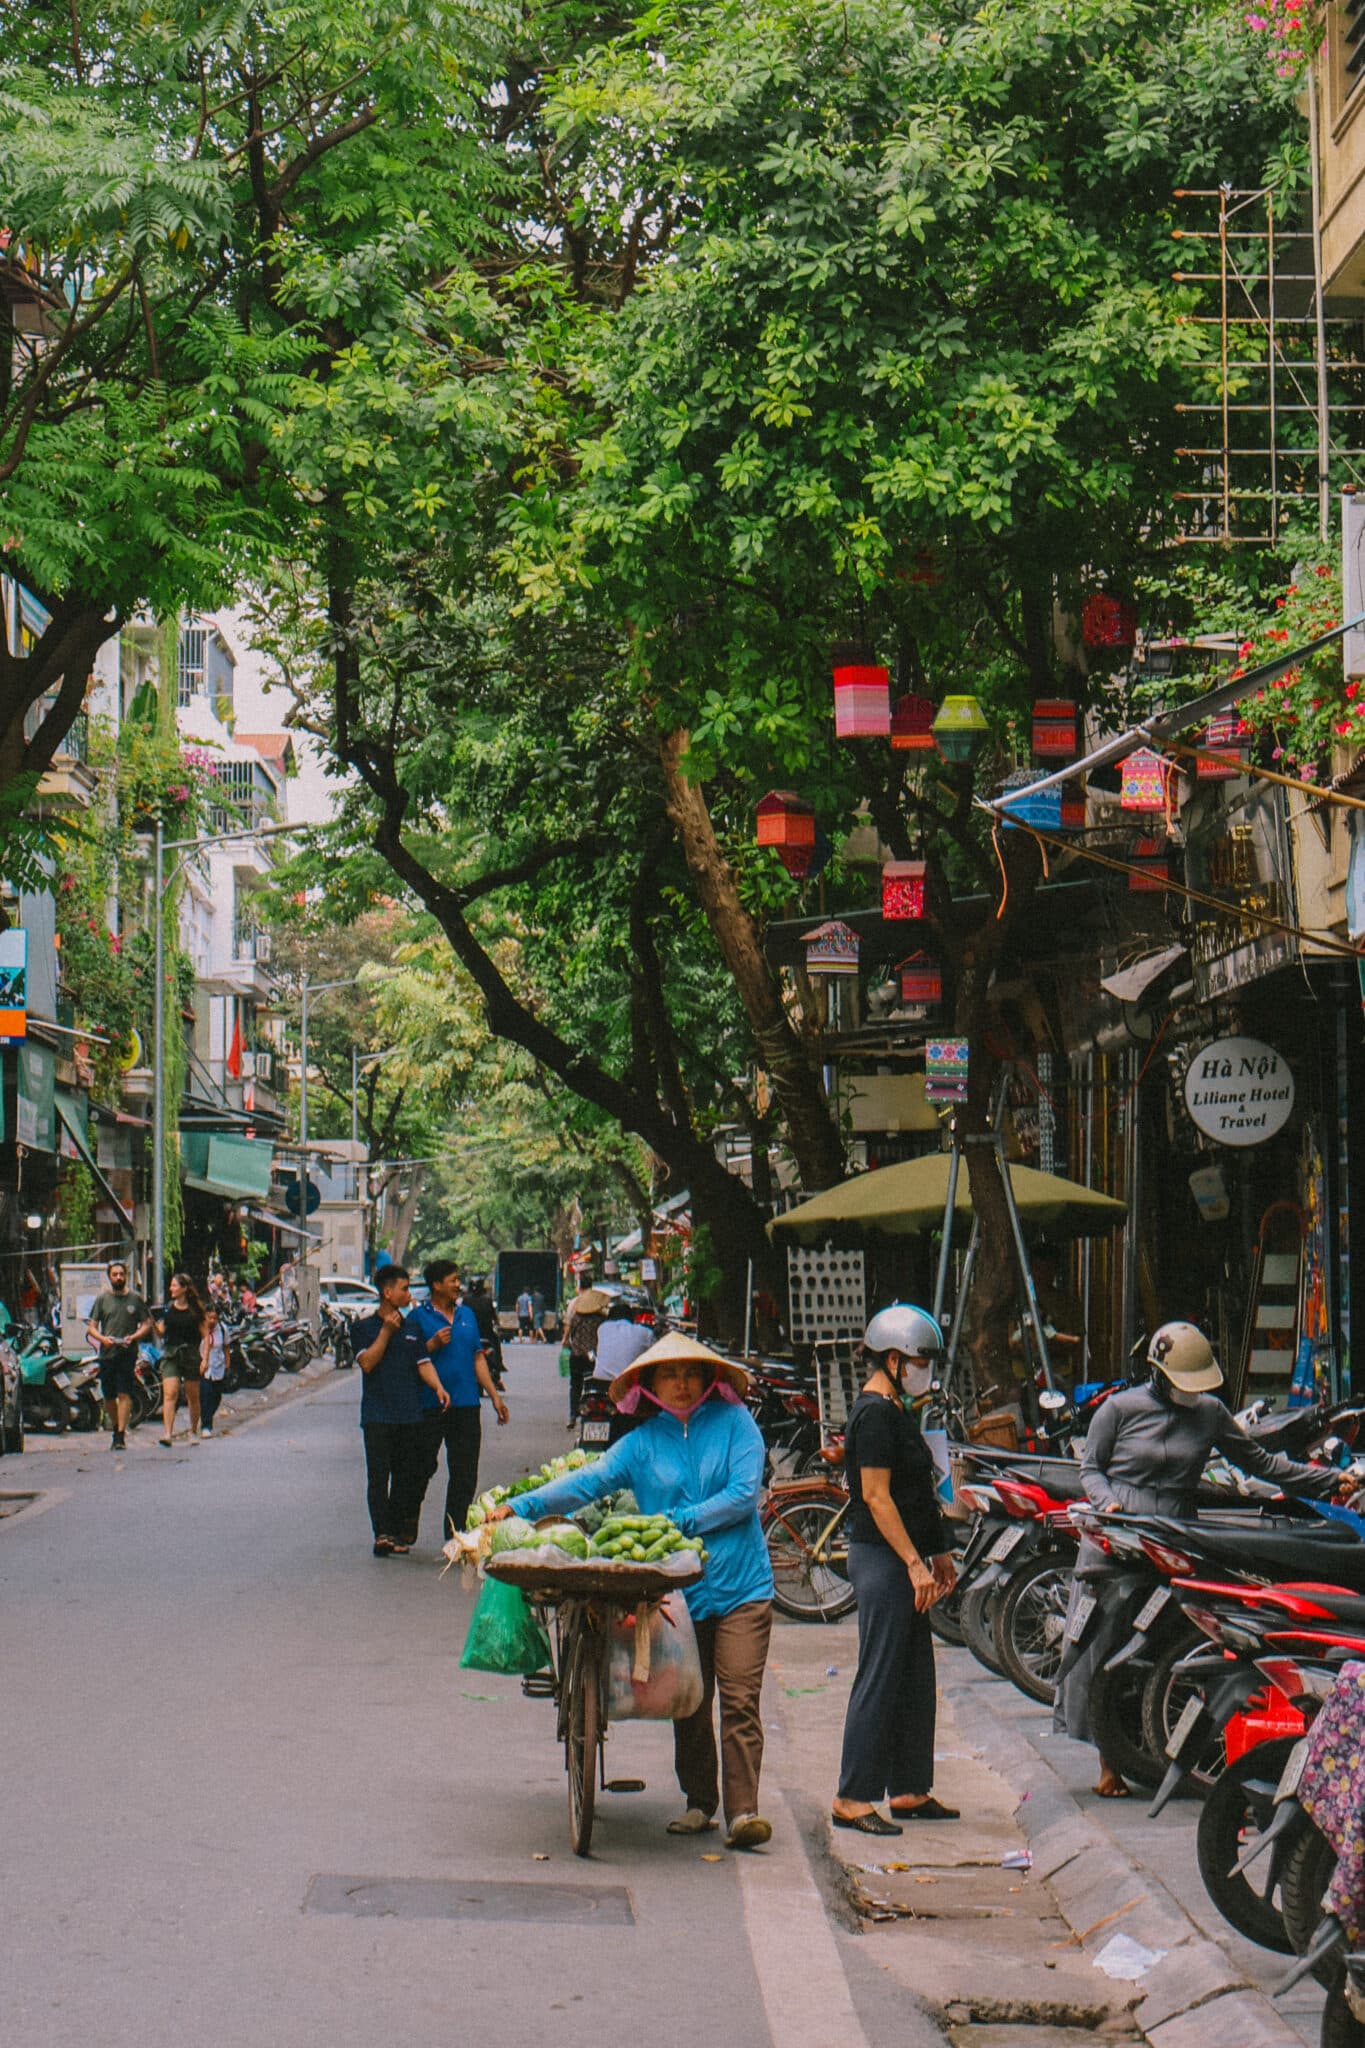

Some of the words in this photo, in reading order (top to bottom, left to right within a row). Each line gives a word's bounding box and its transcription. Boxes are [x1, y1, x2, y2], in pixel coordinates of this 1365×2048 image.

[1201, 1060, 1232, 1079] Hà
[1239, 1056, 1277, 1080] Nội
[1193, 1091, 1246, 1106] Liliane
[1250, 1087, 1290, 1102] Hotel
[1219, 1114, 1267, 1129] Travel
